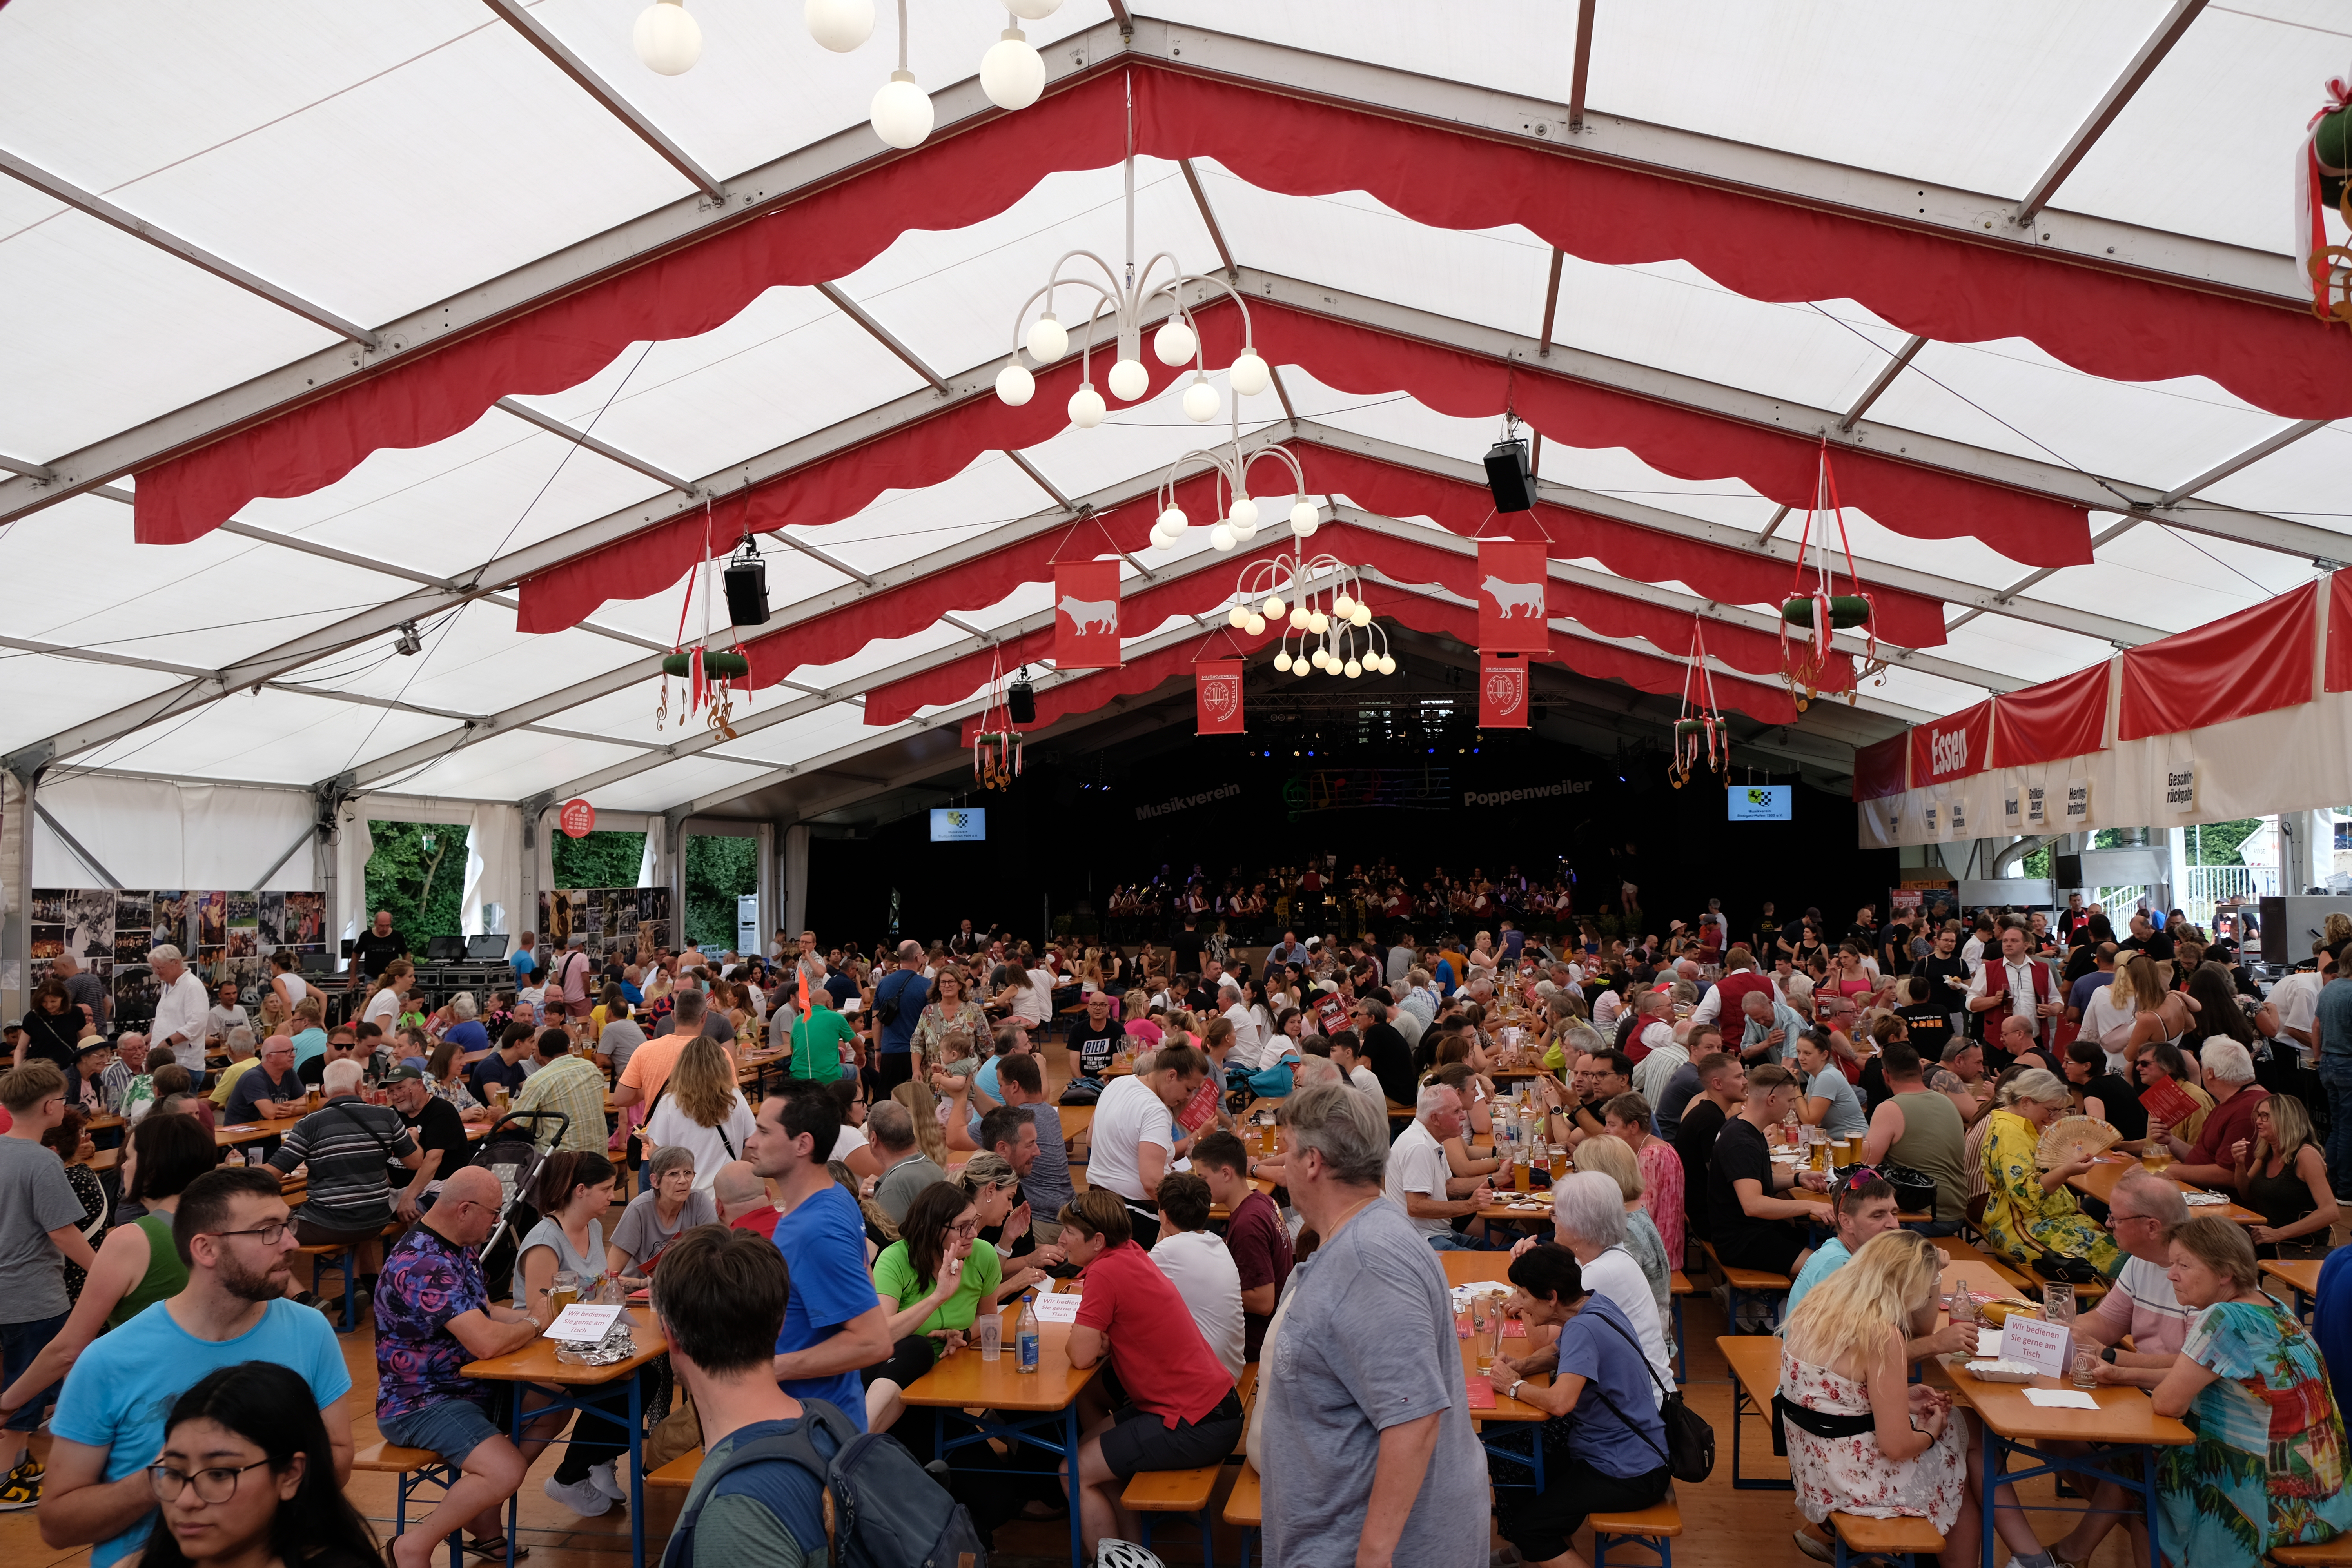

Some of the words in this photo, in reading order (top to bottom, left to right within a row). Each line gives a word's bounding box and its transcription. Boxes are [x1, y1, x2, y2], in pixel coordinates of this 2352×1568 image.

[1217, 681, 1235, 720] POPPENWEILER
[1500, 674, 1520, 713] POPPENWEILER
[1931, 728, 1967, 775] Essen
[2168, 770, 2193, 786] Geschirr-
[1464, 779, 1593, 806] Poppenweiler
[2167, 787, 2192, 804] rückgabe
[1135, 783, 1240, 821] Musikverein
[1085, 1040, 1106, 1054] BIER
[2012, 1322, 2024, 1331] Wir
[2026, 1325, 2059, 1339] bedienen
[2011, 1334, 2021, 1342] Sie
[2022, 1338, 2043, 1347] gerne
[2023, 1348, 2040, 1358] Tisch
